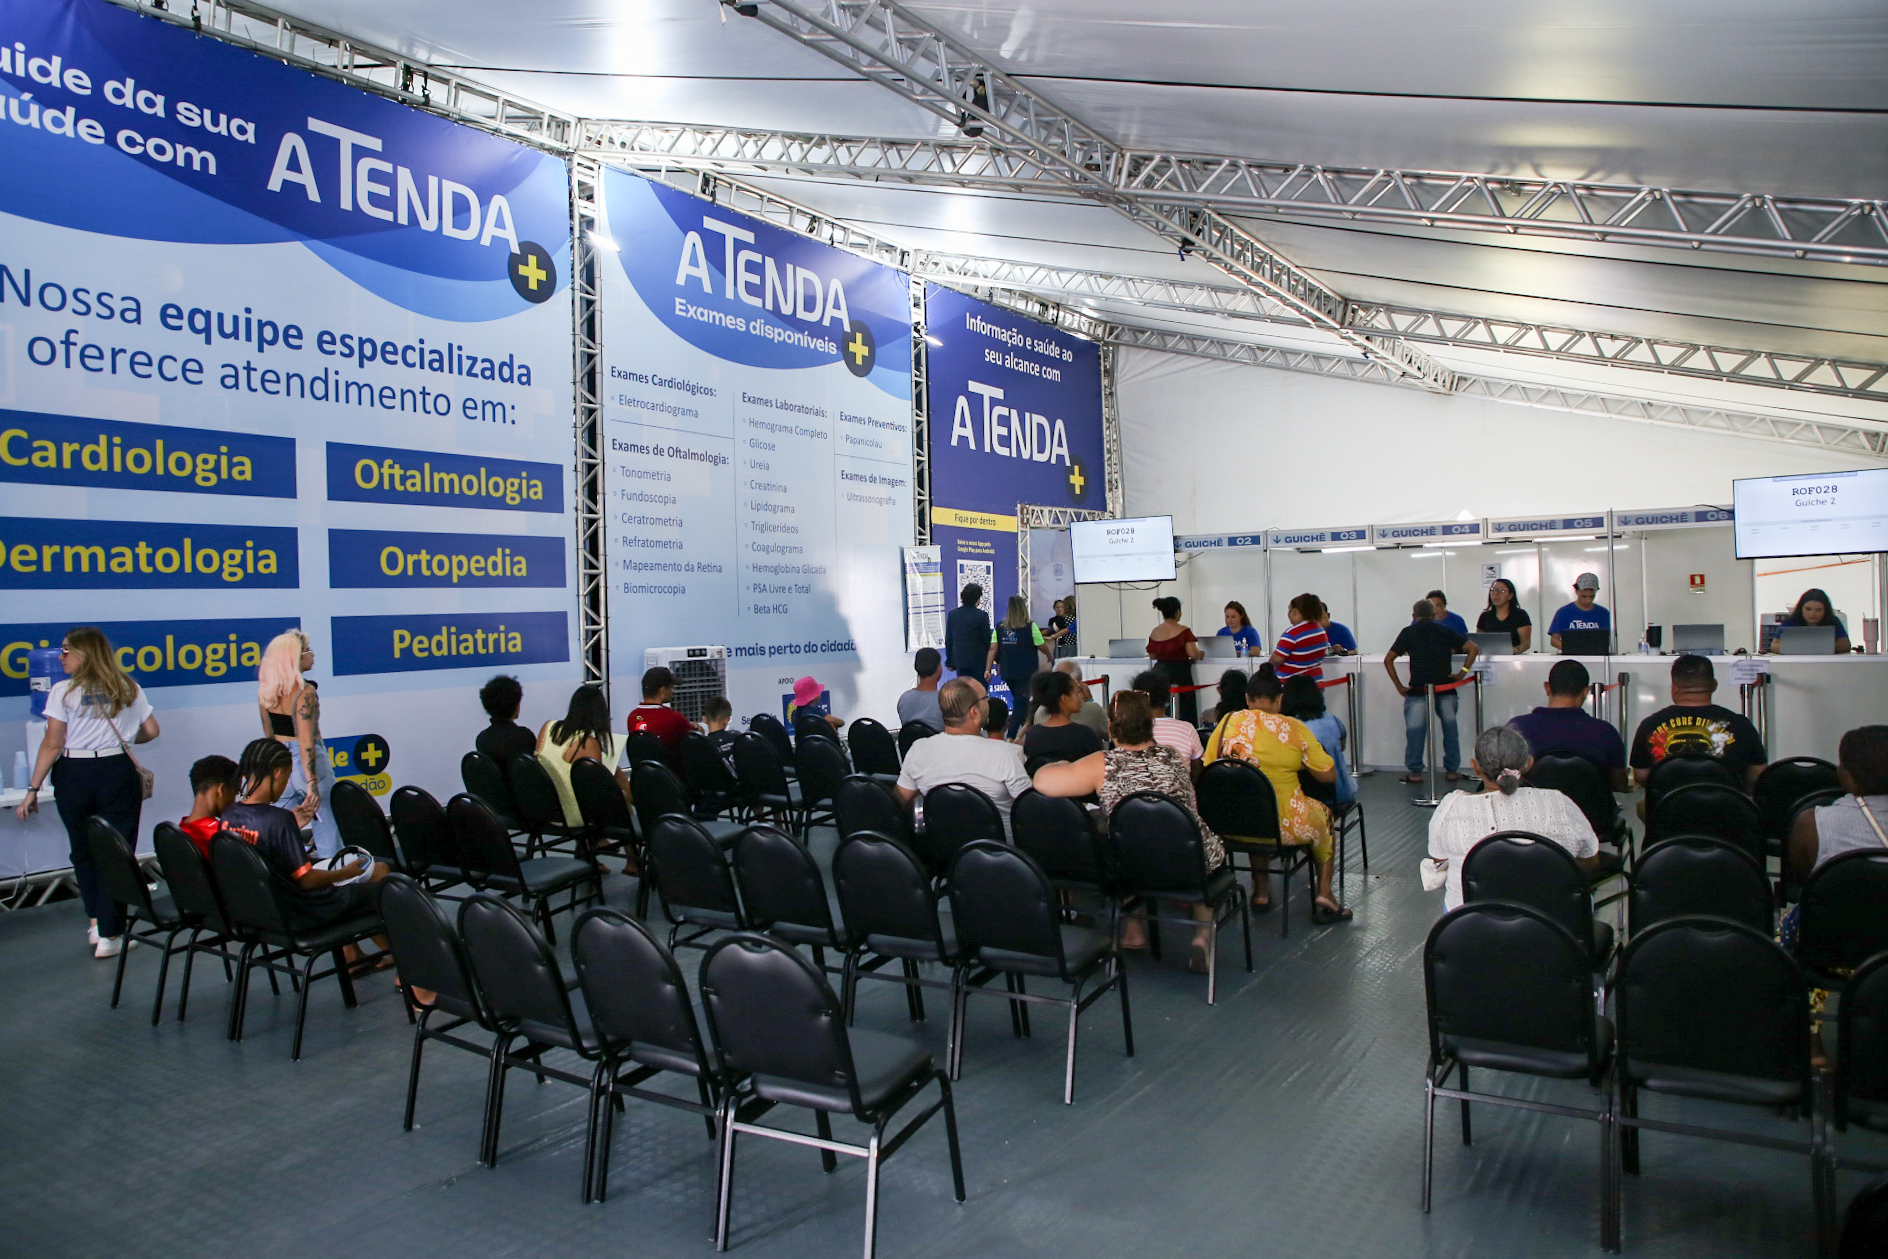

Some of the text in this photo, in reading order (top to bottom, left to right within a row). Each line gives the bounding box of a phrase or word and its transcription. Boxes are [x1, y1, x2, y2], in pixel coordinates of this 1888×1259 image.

[103, 77, 166, 118] da
[176, 101, 256, 144] sua
[116, 129, 217, 175] com
[0, 264, 533, 387] Nossa equipe especializada
[675, 297, 838, 355] Exames disponíveis
[966, 312, 1073, 362] Informação e saúde ao
[984, 350, 1061, 382] seu alcance com
[27, 328, 517, 426] oferece atendimento em:
[610, 365, 718, 398] Exames Cardiológicos:
[618, 394, 699, 419] Eletrocardiograma
[742, 391, 828, 419] Exames Laboratoriais:
[748, 417, 828, 441] Hemograma Completo
[839, 411, 908, 434] Exames Preventivos:
[749, 438, 776, 452] Glicose
[845, 434, 883, 450] Papanicolau
[0, 429, 252, 487] Cardiologia
[612, 438, 730, 467] Exames de Oftalmologia:
[750, 458, 770, 471] Ureia
[354, 457, 545, 505] Oftalmologia
[620, 466, 672, 483] Tonometria
[841, 470, 908, 488] Exames de Imagem:
[750, 479, 787, 494] Creatinina
[621, 490, 677, 506] Fundoscopia
[846, 491, 897, 507] Ultrassonografia
[1795, 497, 1836, 507] Guiche 2
[750, 500, 795, 515] Lipidograma
[621, 513, 683, 529] Ceratrometria
[954, 513, 997, 526] Fique por dentro
[1508, 519, 1593, 532] GUICHÊ 05
[1635, 511, 1728, 525] GUICHÊ 06
[751, 520, 799, 535] Triglicerídeos
[1391, 525, 1471, 538] GUICHÊ 04
[622, 536, 684, 551] Refratometria
[1184, 536, 1252, 548] GUICHÊ 02
[1284, 531, 1357, 543] GUICHÊ 03
[751, 541, 803, 555] Coagulograma
[0, 538, 278, 582] ermatologia
[379, 545, 528, 583] Ortopedia
[623, 559, 723, 575] Mapeamento da Retina
[752, 562, 827, 577] Hemoglobina Glicada
[623, 582, 686, 597] Biomicrocopia
[752, 583, 811, 594] PSA Livre e Total
[753, 603, 789, 615] Beta HCG
[393, 624, 523, 659] Pediatria
[734, 643, 766, 658] mais
[768, 642, 802, 659] perto
[803, 641, 819, 654] do
